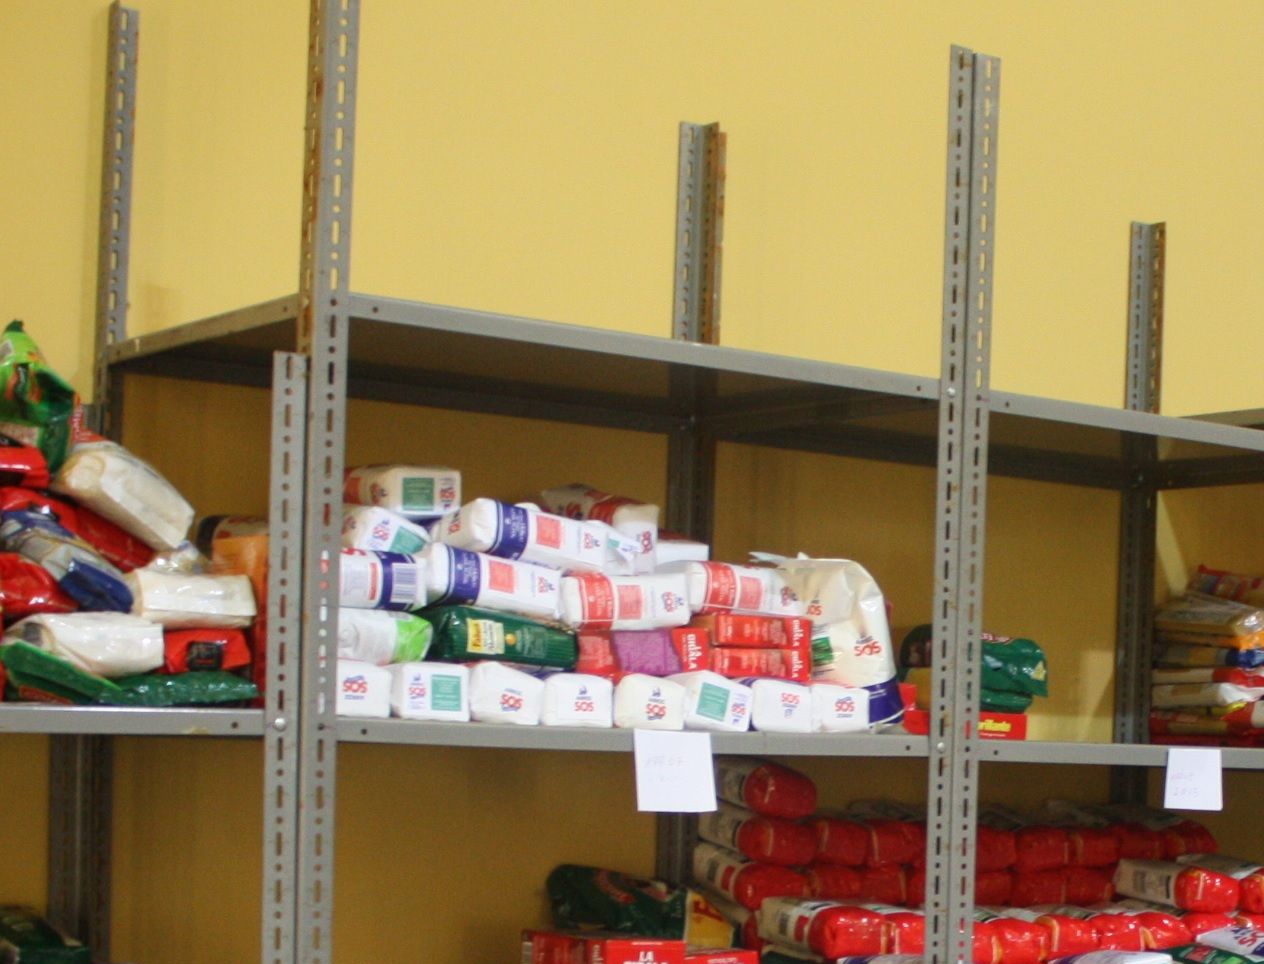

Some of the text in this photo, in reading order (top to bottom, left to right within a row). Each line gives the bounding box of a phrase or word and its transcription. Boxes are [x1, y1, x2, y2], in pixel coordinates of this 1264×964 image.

[853, 639, 882, 657] SOS
[342, 679, 368, 694] SOS
[834, 700, 855, 713] SOS
[977, 719, 1012, 732] rillante
[638, 951, 654, 962] LA
